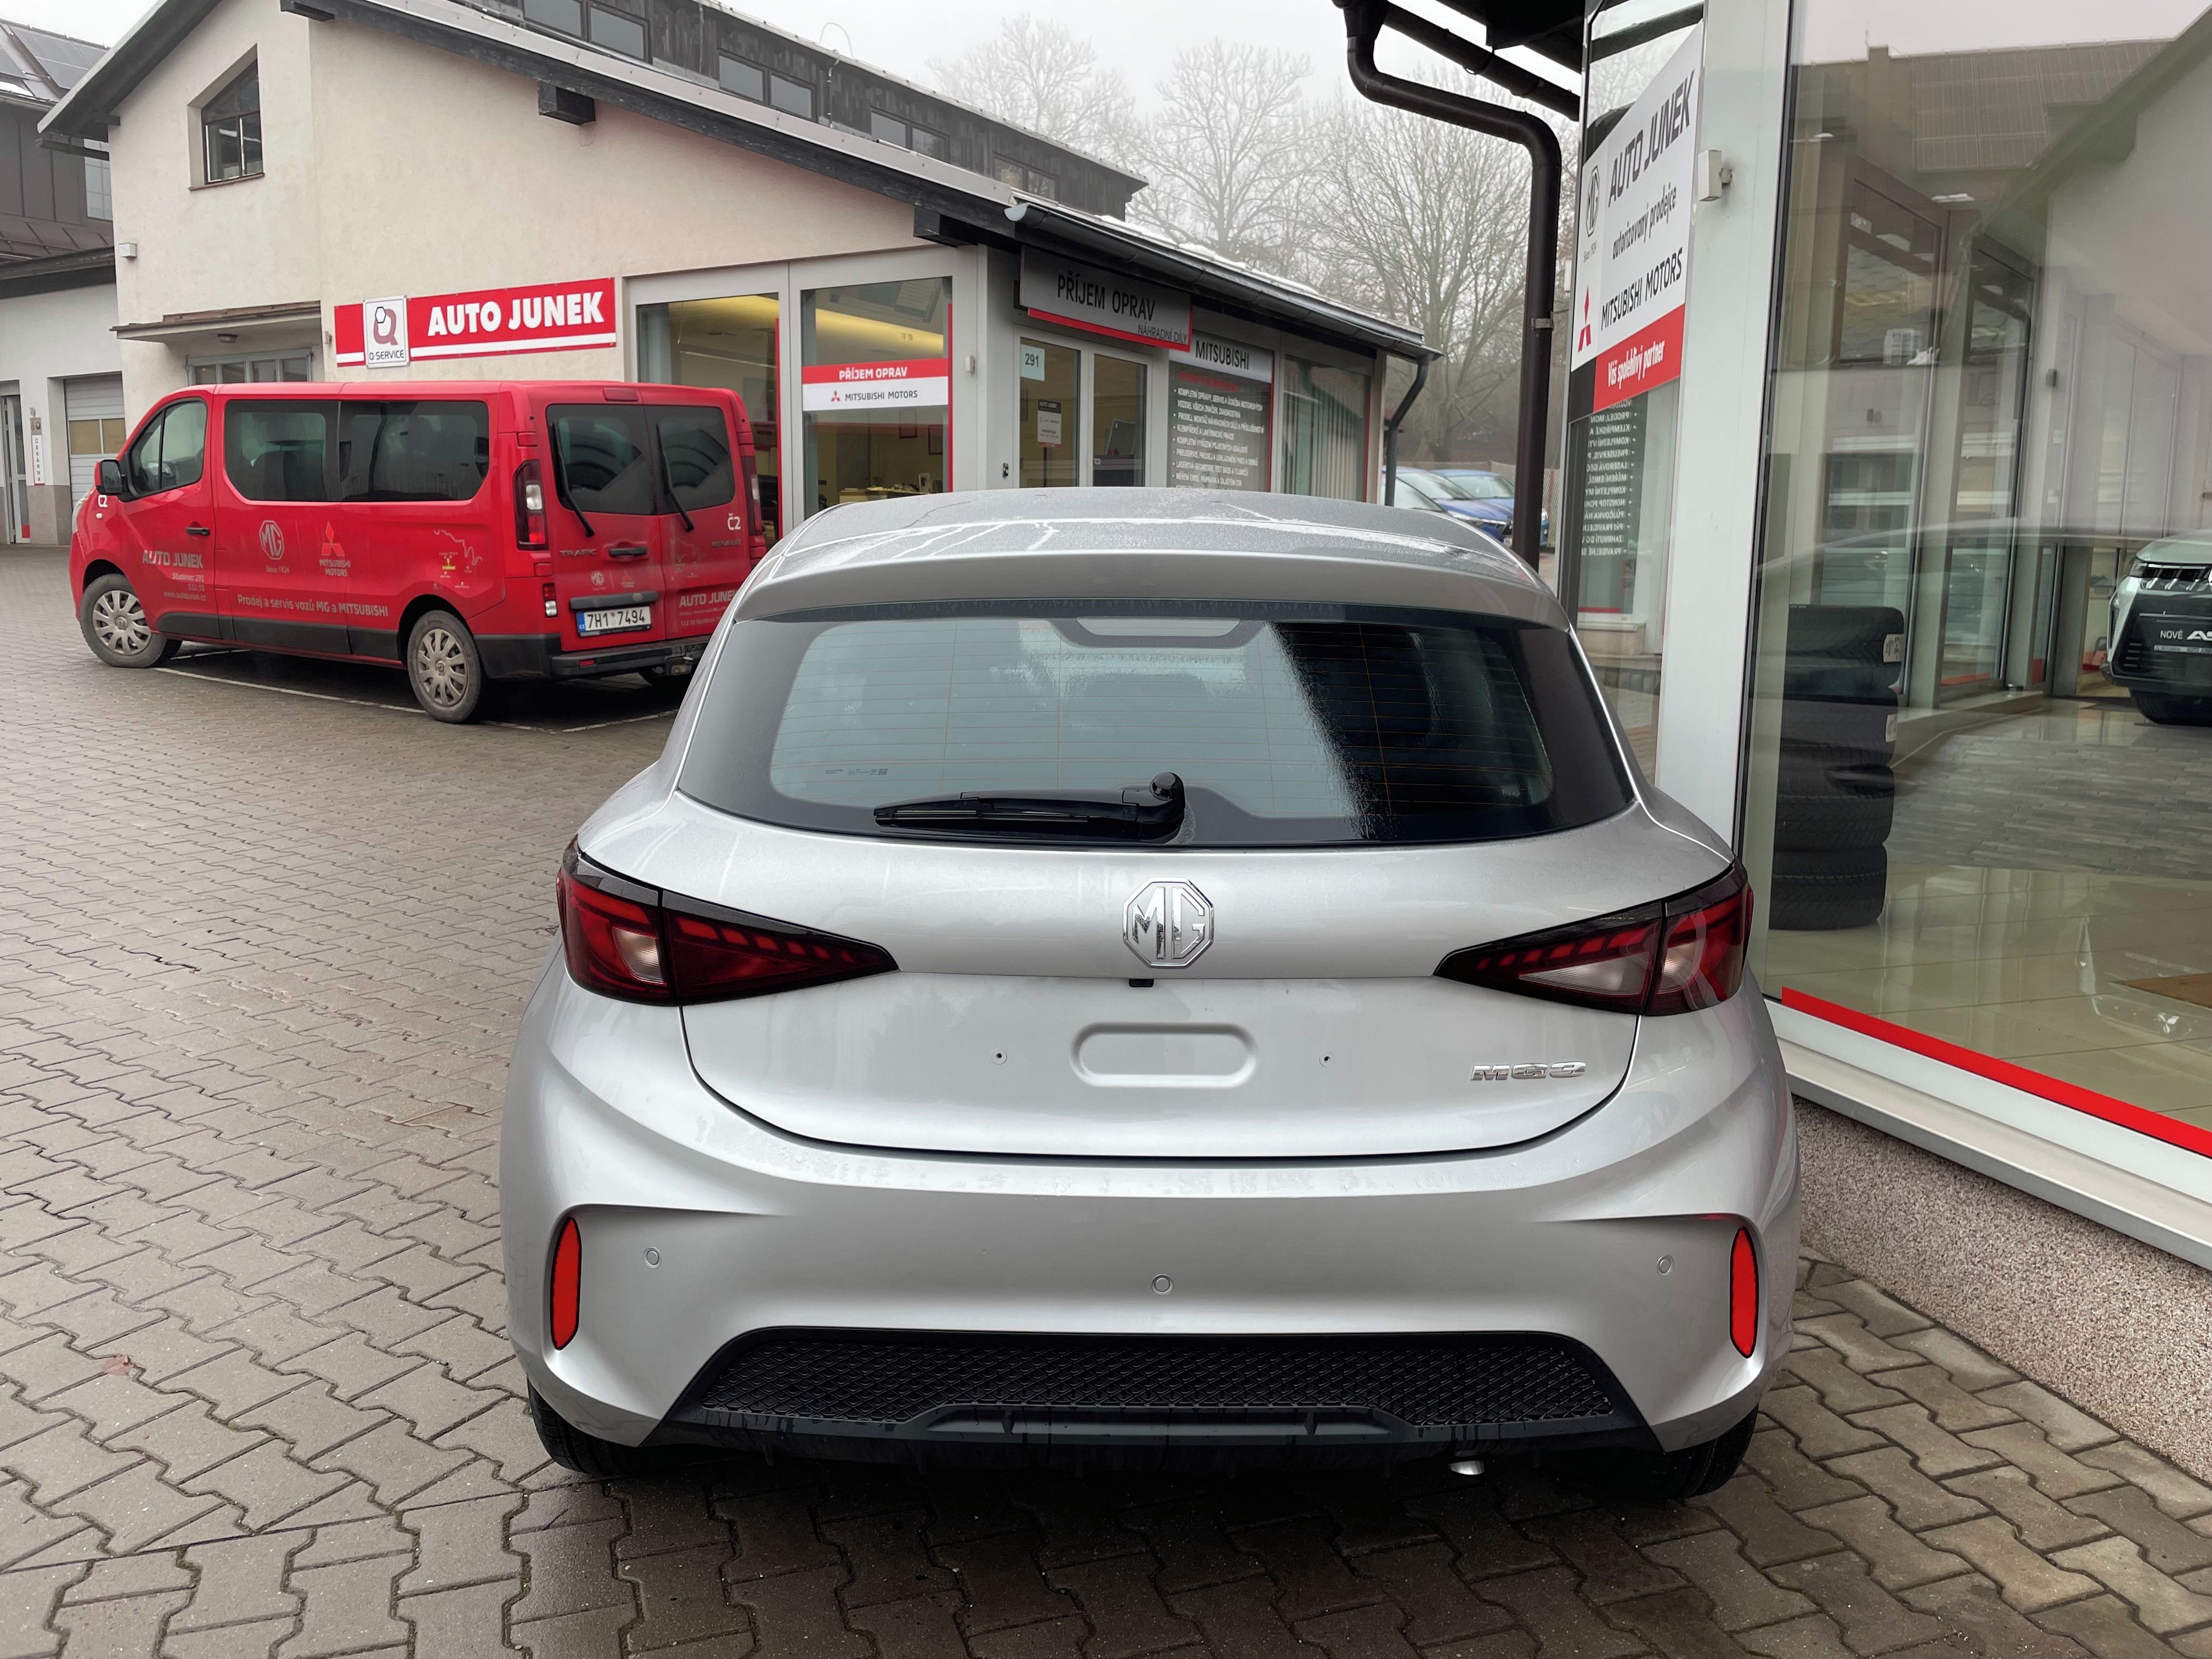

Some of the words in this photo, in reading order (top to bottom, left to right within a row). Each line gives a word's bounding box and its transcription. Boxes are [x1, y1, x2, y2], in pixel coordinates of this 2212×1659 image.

[1609, 129, 1644, 207] AUTO
[1644, 69, 1695, 172] JUNEK
[1613, 202, 1649, 260] autorizovaný
[1649, 182, 1677, 239] prodejce
[1057, 270, 1106, 310] PŘÍJEM
[1112, 290, 1155, 321] OPRAV
[1601, 277, 1643, 331] MITSUBISHI
[1645, 247, 1683, 302] MOTORS
[427, 300, 501, 337] AUTO
[507, 291, 605, 330] JUNEK
[1138, 323, 1172, 341] NÁHRADNÍ
[1173, 328, 1187, 345] DÍLY
[1025, 353, 1039, 368] 291
[1195, 340, 1250, 370] MITSUBISHI
[1643, 340, 1665, 379] partner
[839, 367, 873, 381] PŘÍJEM
[876, 366, 907, 379] OPRAV
[845, 392, 885, 402] MITSUBISHI
[888, 390, 918, 399] MOTORS
[727, 512, 741, 531] Č2
[261, 523, 283, 556] MG
[142, 550, 170, 566] AUTO
[173, 552, 204, 569] JUNEK
[319, 559, 351, 568] MITSUBISHI
[560, 549, 597, 558] TRAFIC
[325, 568, 348, 577] MOTORS
[237, 594, 262, 609] Prodej
[264, 599, 269, 608] a
[270, 598, 294, 610] servis
[296, 599, 314, 611] vozů
[315, 601, 330, 612] MG
[331, 603, 337, 613] a
[338, 603, 388, 617] MITSUBISHI
[679, 593, 706, 608] AUTO
[587, 612, 608, 629] 7H1
[617, 609, 645, 625] 7494
[2160, 629, 2183, 640] NOVÉ
[1130, 885, 1206, 960] MG
[1470, 1061, 1587, 1081] MG3
